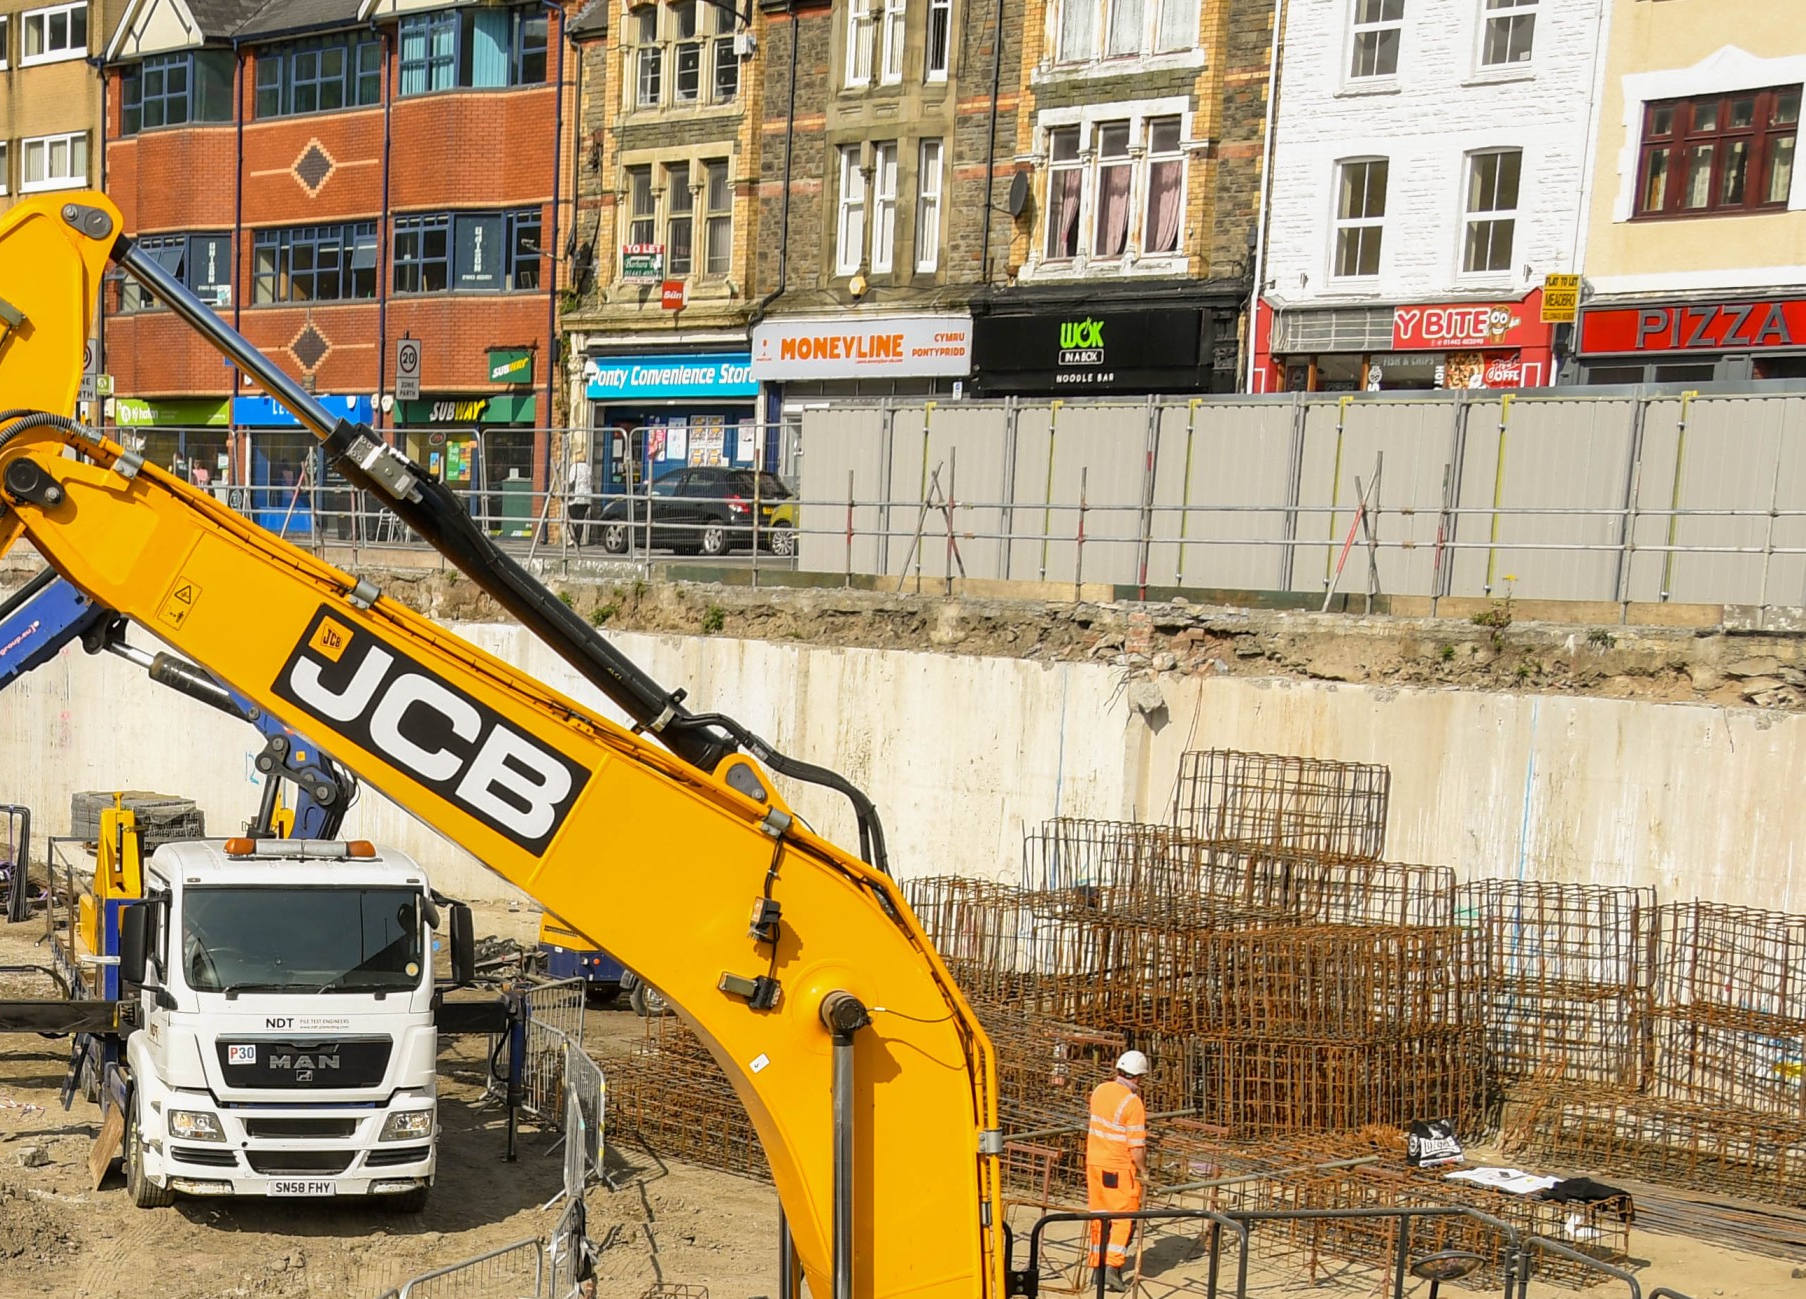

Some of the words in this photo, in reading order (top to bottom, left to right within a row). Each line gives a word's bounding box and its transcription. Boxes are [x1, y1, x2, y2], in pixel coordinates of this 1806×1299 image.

[628, 245, 640, 254] TO
[643, 244, 660, 254] LET
[1395, 310, 1420, 339] Y
[1422, 308, 1492, 338] BITE
[1635, 302, 1792, 348] PIZZA
[934, 332, 965, 342] CYMRU
[1060, 319, 1104, 349] WOK
[780, 334, 905, 360] MONEYLINE
[912, 347, 965, 357] PONTYPRIDD
[402, 352, 415, 364] 20
[1065, 352, 1074, 362] IN
[1081, 351, 1097, 362] BOX
[492, 357, 530, 378] SUBWAY
[589, 367, 628, 389] Ponty
[631, 365, 716, 386] Convenience
[1056, 373, 1093, 383] NOODLE
[1097, 372, 1114, 382] BAR
[429, 399, 486, 422] SUBWAY
[324, 626, 341, 648] JCB
[290, 645, 572, 839] JCB
[266, 1018, 294, 1028] NDT
[230, 1047, 254, 1059] P30
[269, 1055, 340, 1069] MAN
[276, 1182, 305, 1193] SN58
[308, 1182, 330, 1193] FHY
